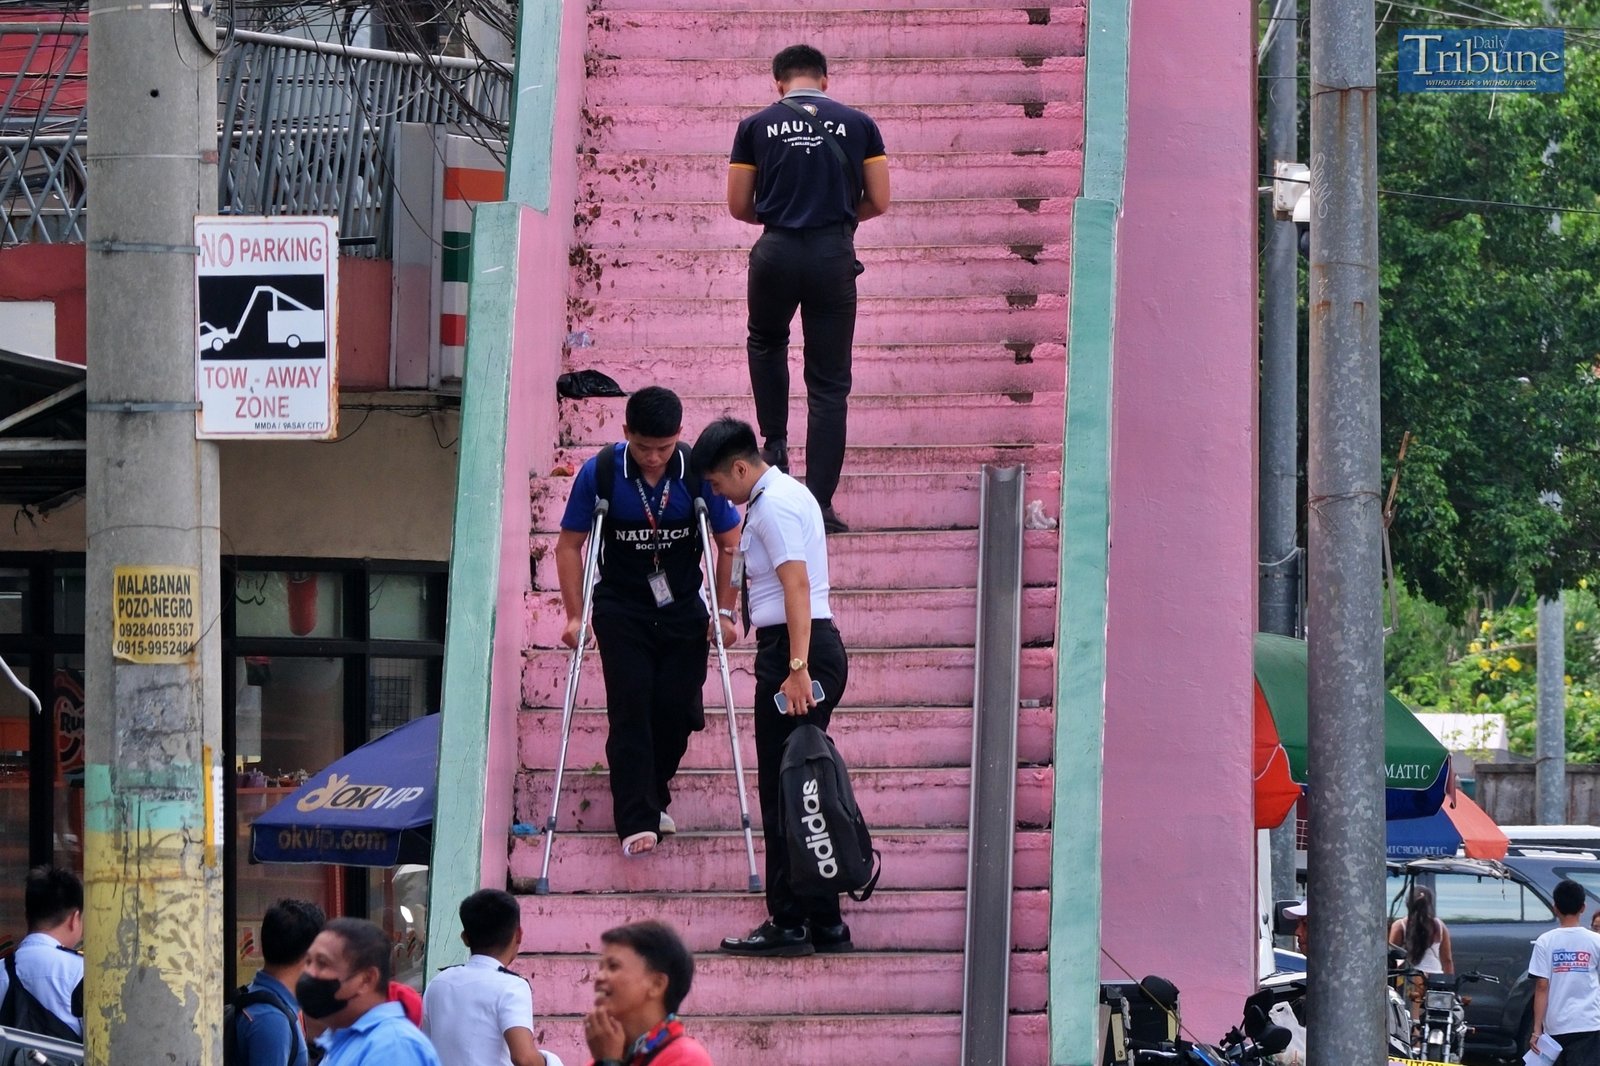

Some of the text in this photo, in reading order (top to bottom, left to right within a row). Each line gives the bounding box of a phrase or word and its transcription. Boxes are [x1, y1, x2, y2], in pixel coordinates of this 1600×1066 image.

[766, 120, 847, 138] NAUTCA
[201, 232, 322, 268] NO PARKING
[203, 366, 248, 389] TOW
[265, 366, 322, 389] AWAY
[235, 396, 290, 419] ZONE
[254, 422, 276, 430] MMDA
[307, 421, 325, 430] CITY
[635, 541, 673, 551] SOCETY
[117, 575, 191, 596] MALABANAN
[118, 598, 193, 618] POZO-NEGRO
[119, 623, 194, 637] 09284085367
[1385, 763, 1430, 779] MATIC
[277, 824, 388, 851] okvip.com
[801, 778, 838, 878] adidas
[1553, 952, 1590, 961] BONG GO
